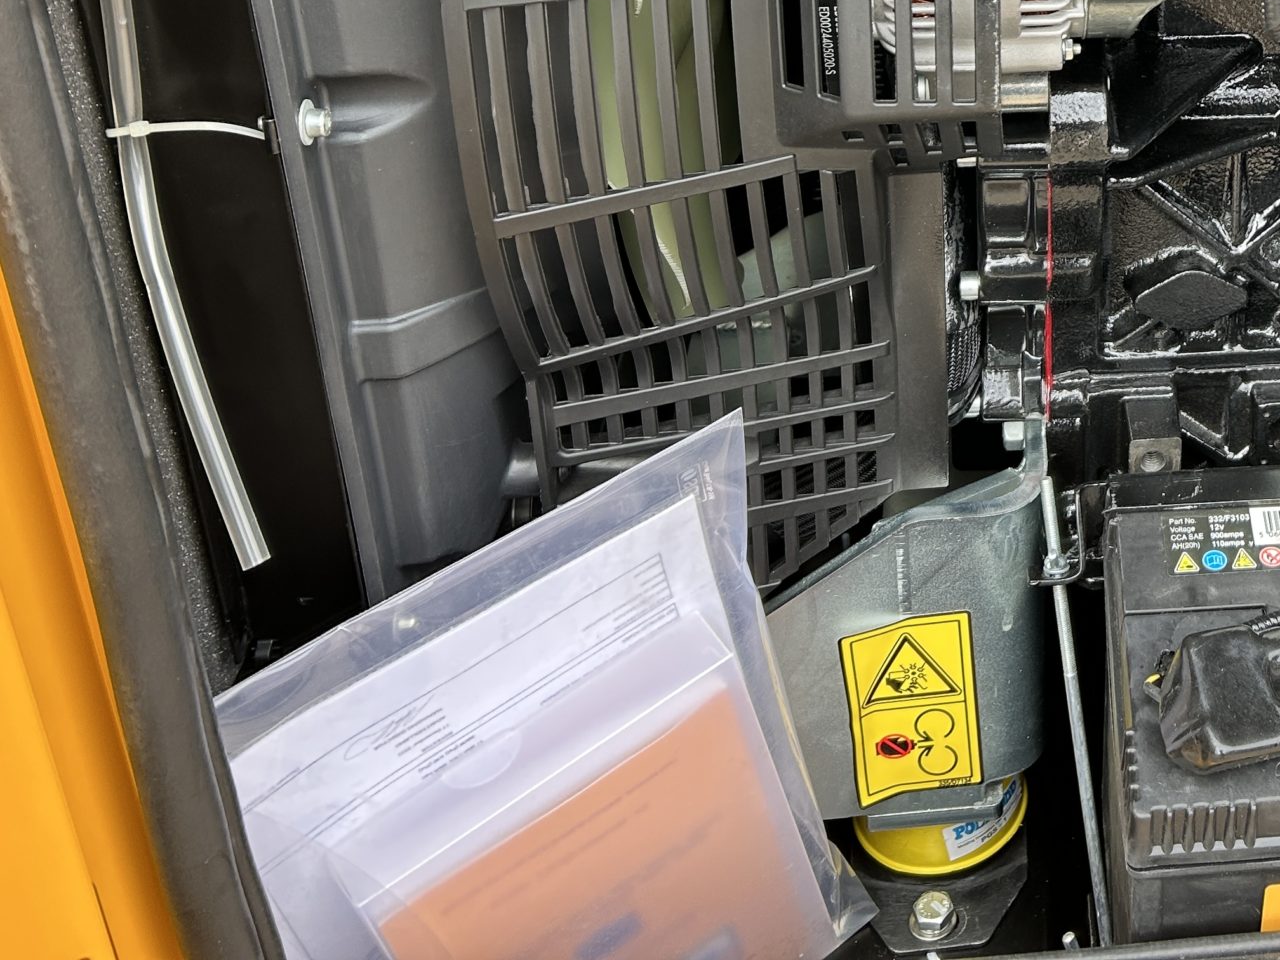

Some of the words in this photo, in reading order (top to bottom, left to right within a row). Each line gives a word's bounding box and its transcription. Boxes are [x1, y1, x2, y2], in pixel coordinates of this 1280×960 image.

[818, 5, 837, 76] ED0024405020-S
[1169, 517, 1186, 526] Part
[1186, 517, 1198, 525] No.
[1208, 513, 1250, 523] 332/F3103
[1169, 526, 1196, 534] Voltage
[1170, 533, 1188, 541] CCA
[1188, 532, 1204, 540] SAE
